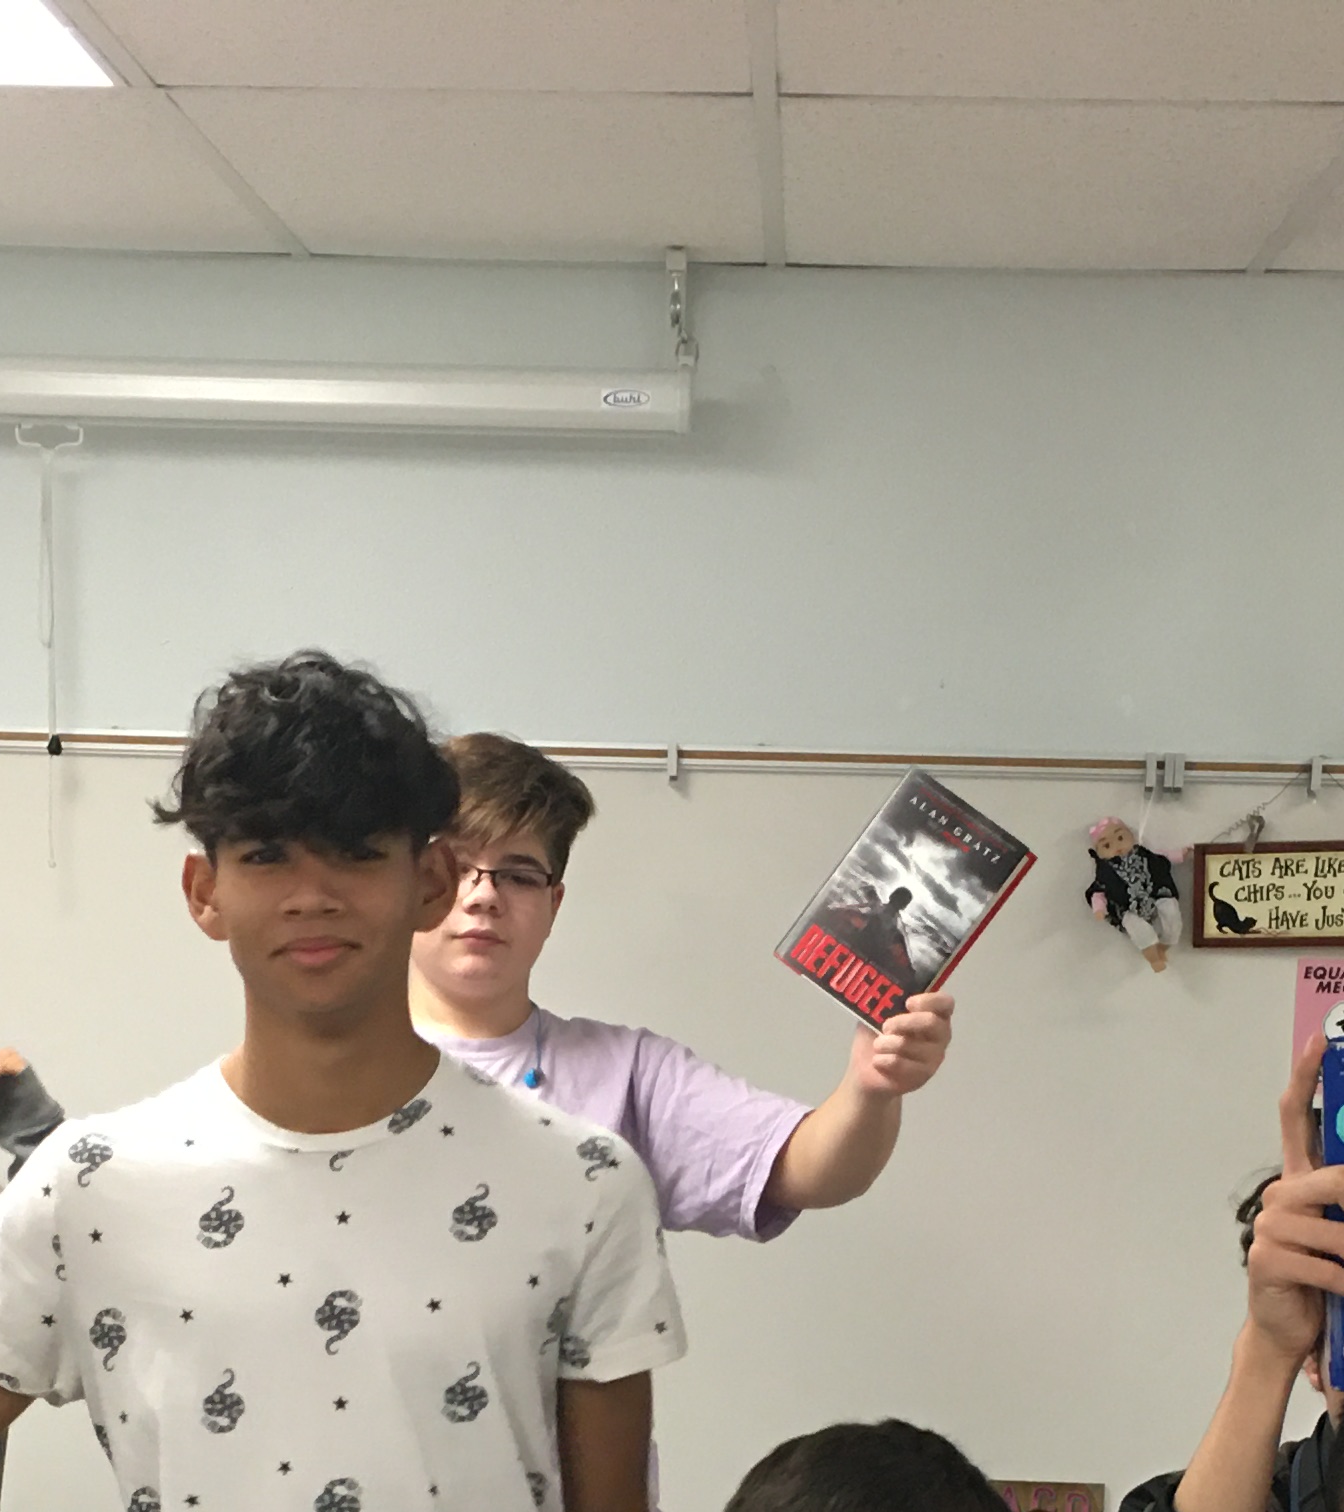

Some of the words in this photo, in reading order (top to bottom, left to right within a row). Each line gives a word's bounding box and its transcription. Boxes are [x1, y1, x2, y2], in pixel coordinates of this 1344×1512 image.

[908, 795, 950, 827] ALAN
[952, 825, 1002, 865] GRATZ
[1219, 857, 1262, 880] CATS
[1271, 858, 1308, 879] ARE
[1302, 881, 1335, 900] YOU
[1267, 908, 1309, 930] HAVE
[790, 923, 905, 1024] REFUGEE
